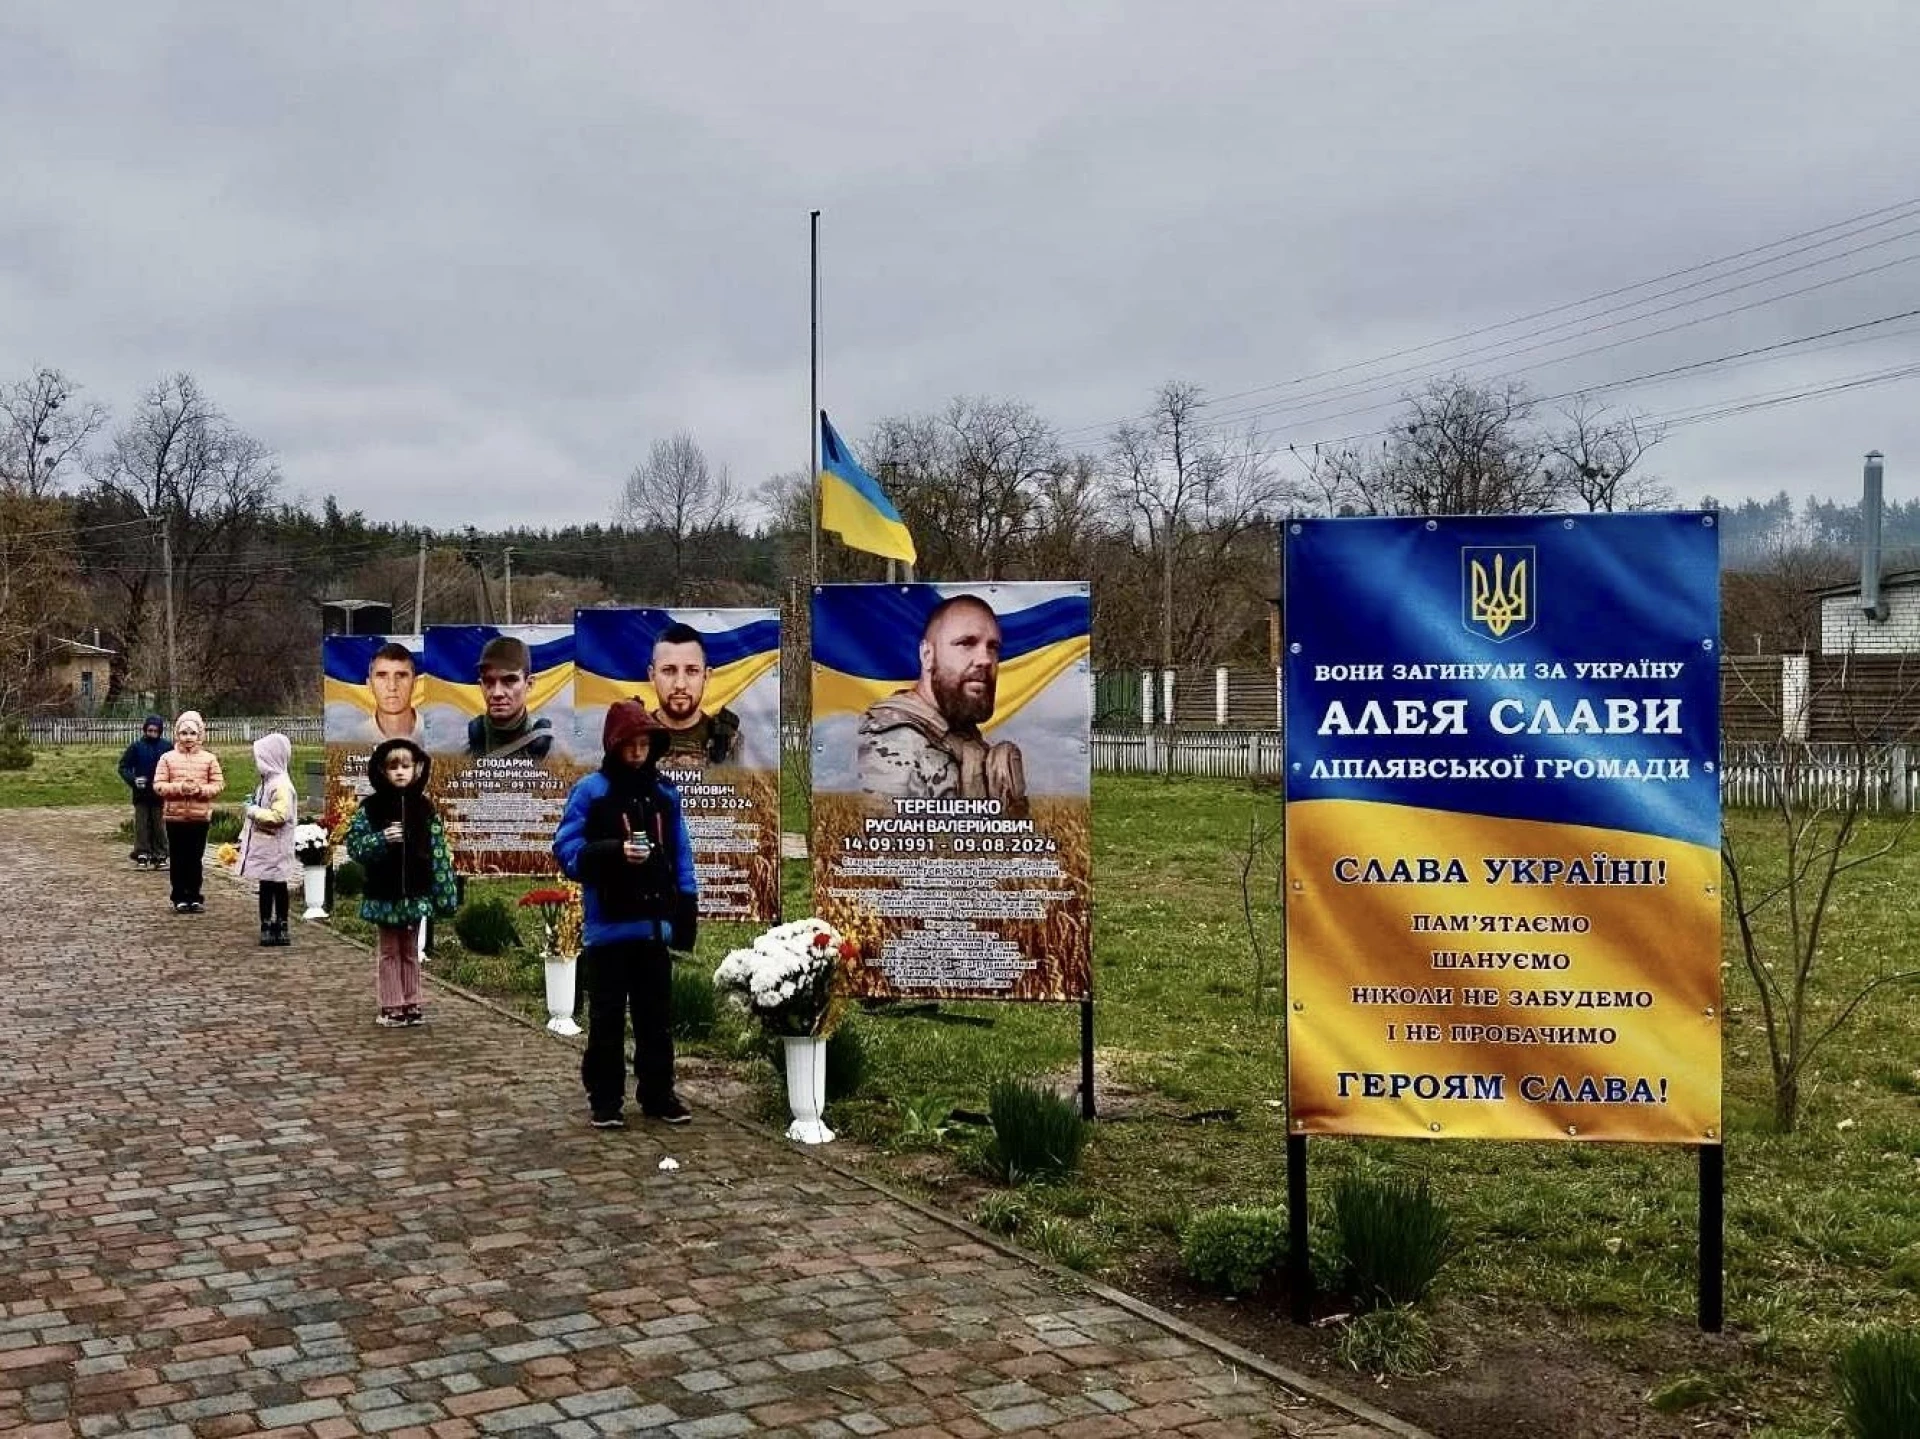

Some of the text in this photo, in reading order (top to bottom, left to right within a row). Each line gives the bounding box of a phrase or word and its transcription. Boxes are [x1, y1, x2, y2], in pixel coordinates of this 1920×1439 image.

[1315, 659, 1685, 681] ВОНИ ЗАГИНУЛИ ЗА УКРАЇНУ
[1317, 698, 1683, 735] АЛЕЯ СЛАВИ
[476, 758, 534, 770] СПОДАРИК
[1310, 755, 1690, 781] ЛІПЛЯВСЬКОЇ ГРОМАДИ
[680, 798, 754, 809] 09.03.2024
[893, 799, 1002, 817] ТЕРЕЩЕНКО
[865, 817, 1034, 834] РУСЛАН ВАЛЕРІЙОВИЧ
[843, 837, 935, 852] 14.09.1991
[953, 837, 1057, 853] 09.08.2024
[1335, 855, 1666, 885] СЛАВА УКРАЇНІ!
[1432, 952, 1570, 970] ШАНУЄМО
[1351, 988, 1653, 1009] НІКОЛИ НЕ ЗАБУДЕМО
[1387, 1025, 1617, 1044] І НЕ ПРОБАЧИМО
[1337, 1074, 1668, 1104] ГЕРОЯМ СЛАВА!
